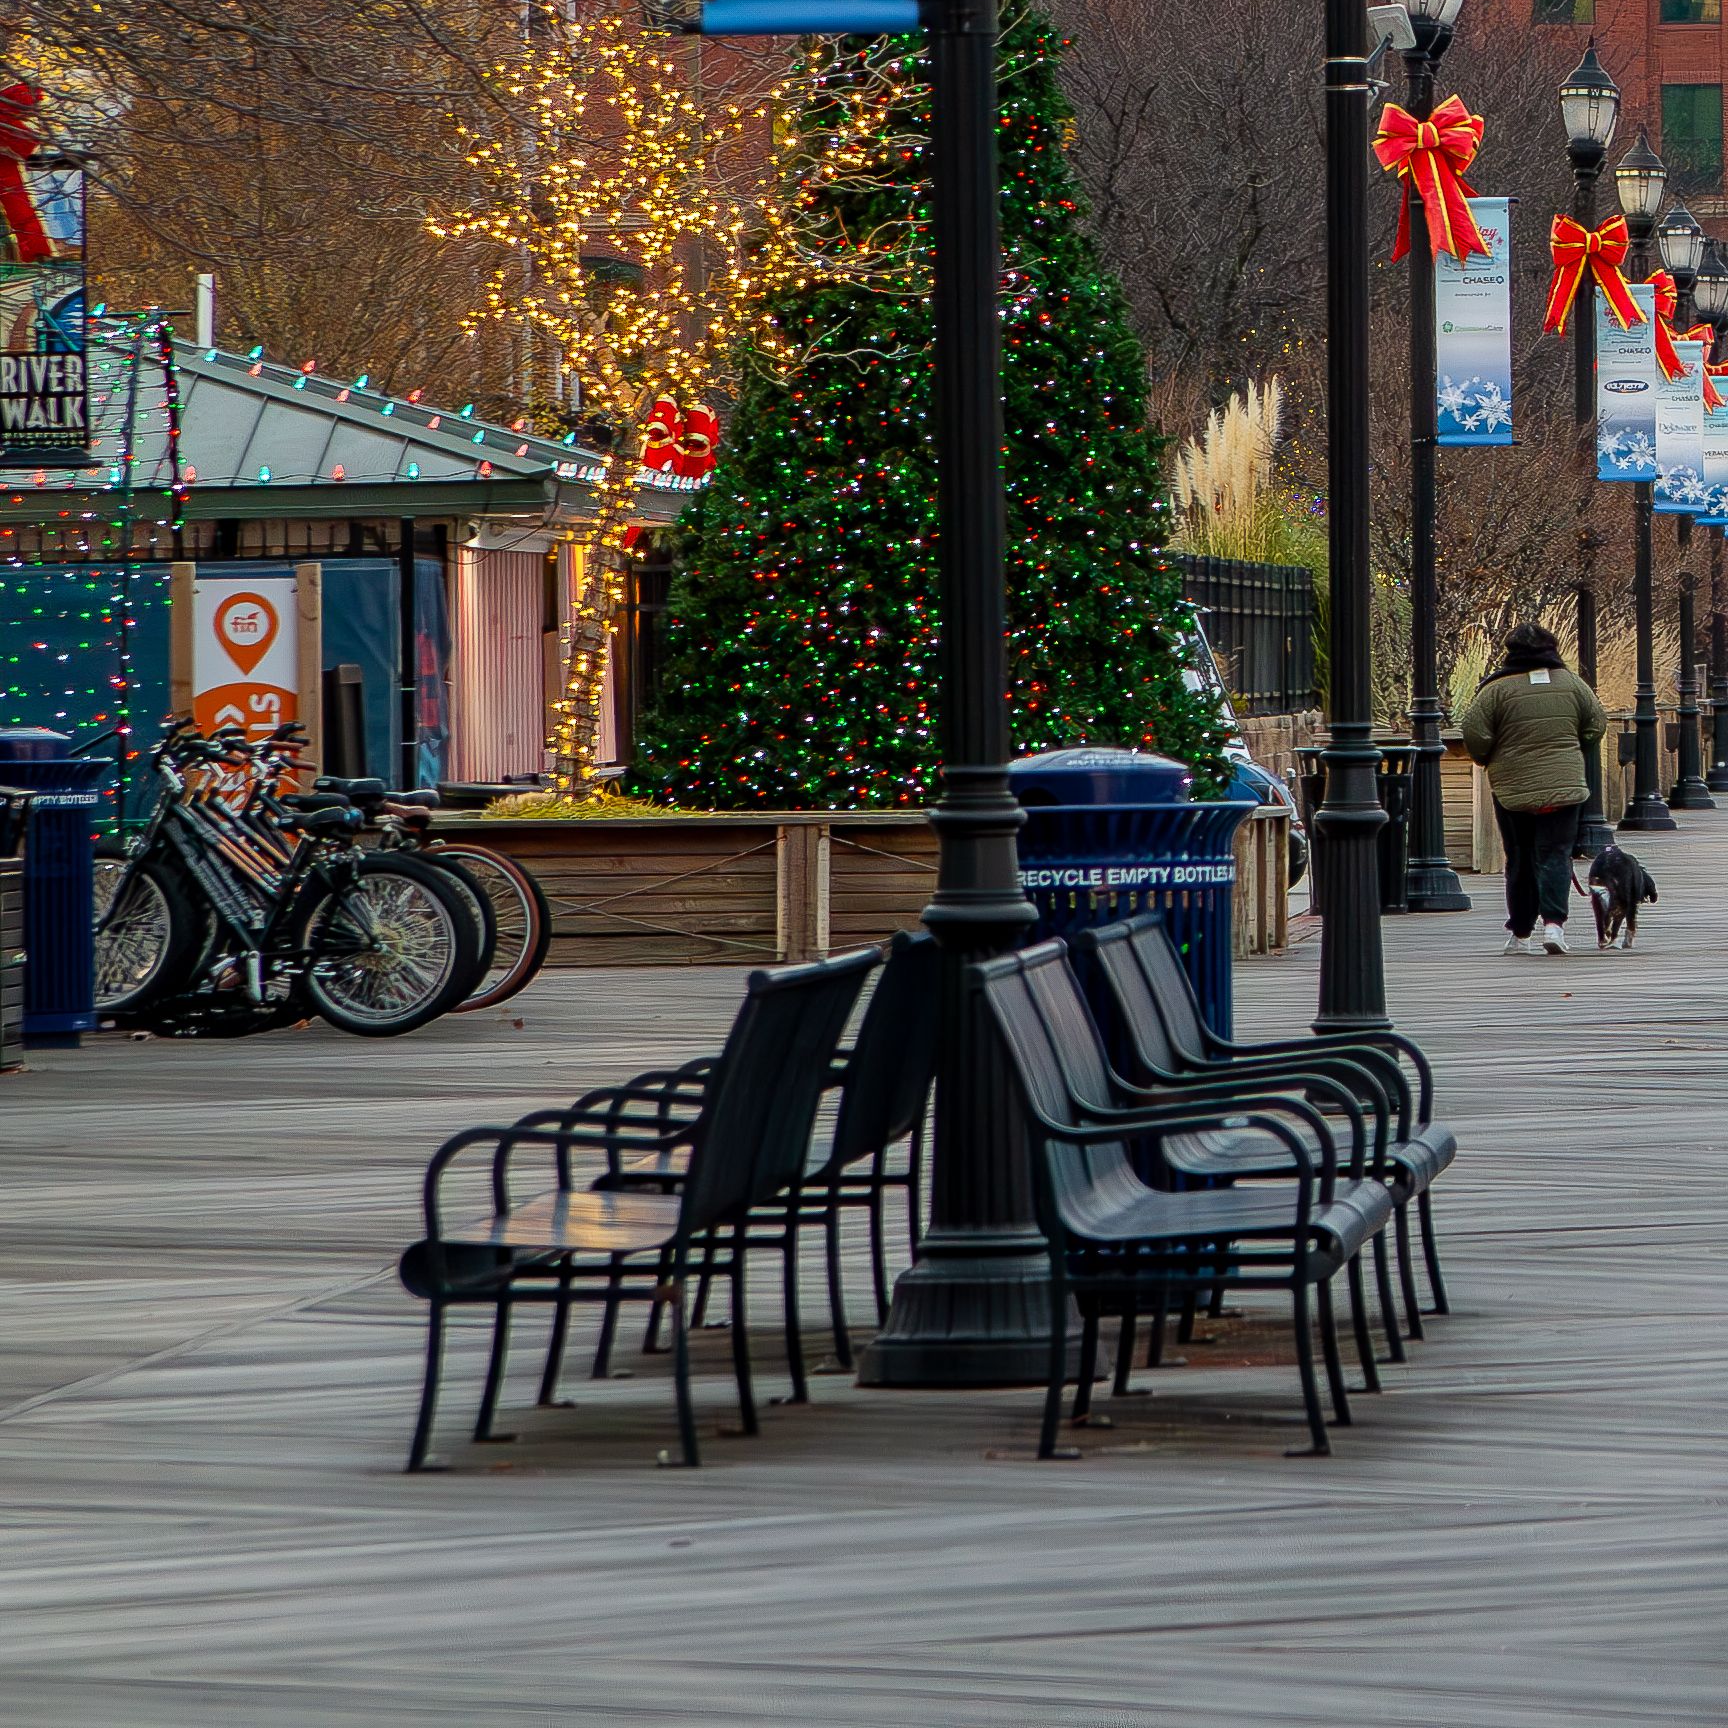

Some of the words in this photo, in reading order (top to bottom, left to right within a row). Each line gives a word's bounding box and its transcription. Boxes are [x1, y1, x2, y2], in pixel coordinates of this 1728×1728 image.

[1462, 276, 1496, 285] CHASE
[1, 355, 84, 393] RIVER
[2, 396, 85, 430] WALK
[1016, 869, 1102, 886] RECYCLE
[1107, 867, 1170, 884] EMPTY
